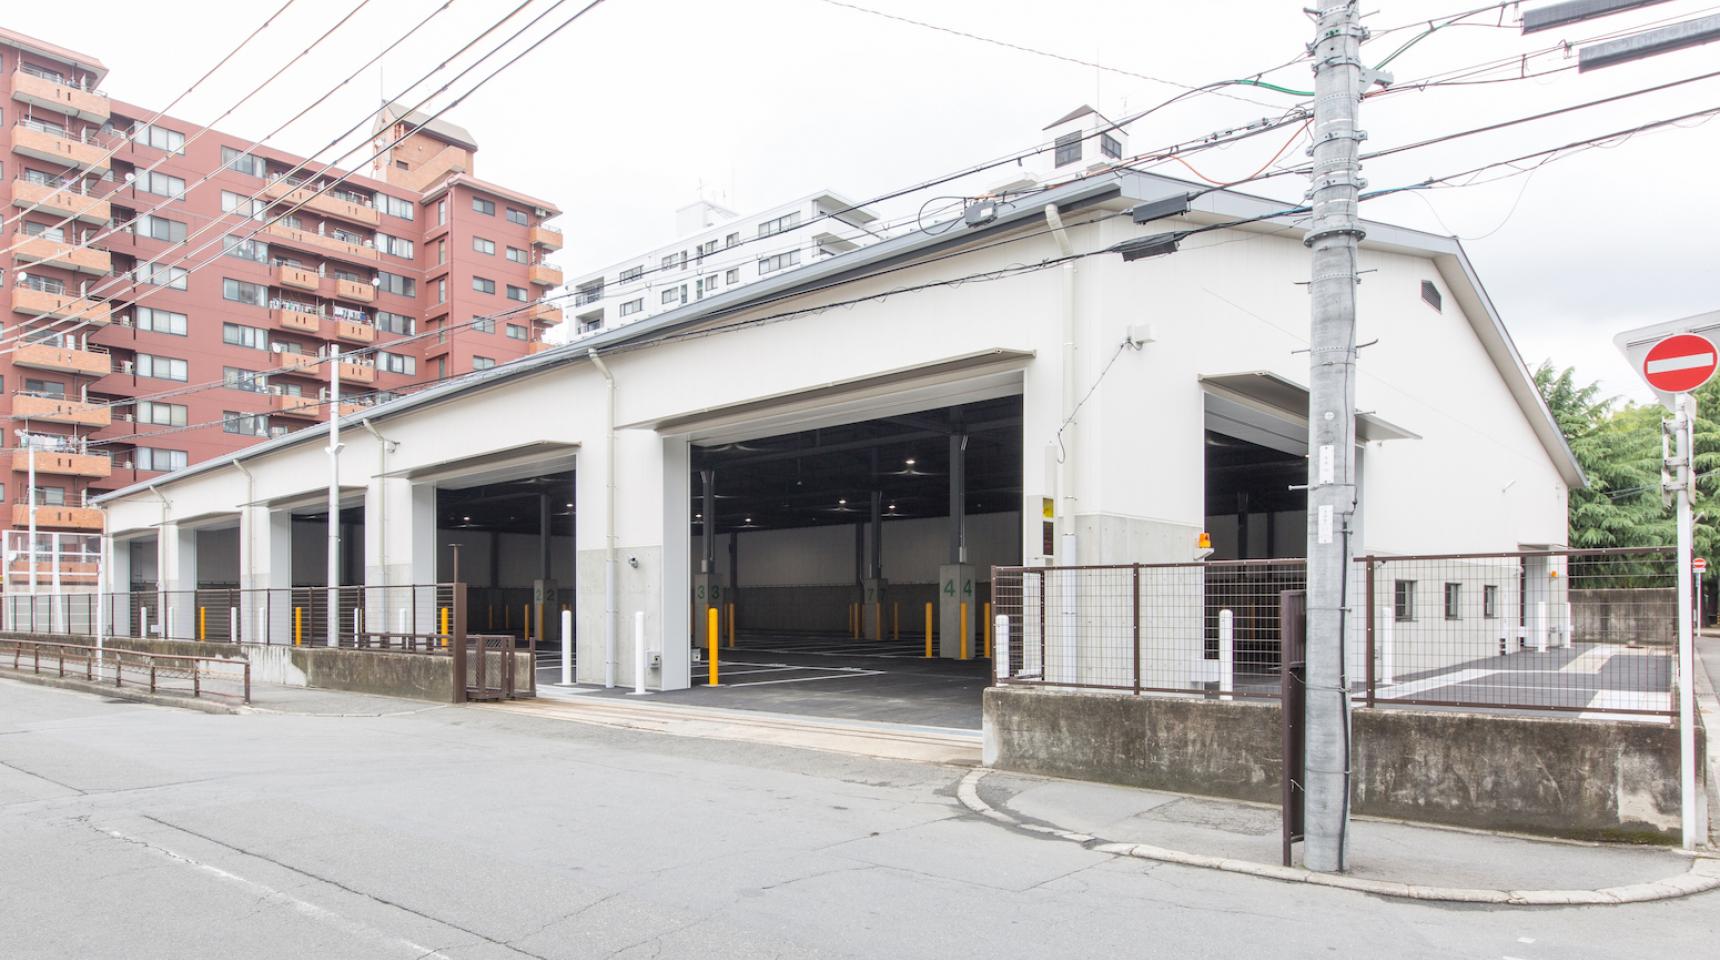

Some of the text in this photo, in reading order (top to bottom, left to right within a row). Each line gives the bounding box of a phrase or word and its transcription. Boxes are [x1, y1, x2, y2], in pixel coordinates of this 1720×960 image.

[547, 590, 555, 600] 2
[697, 585, 705, 600] 3
[944, 580, 956, 597] 4
[963, 580, 972, 597] 4
